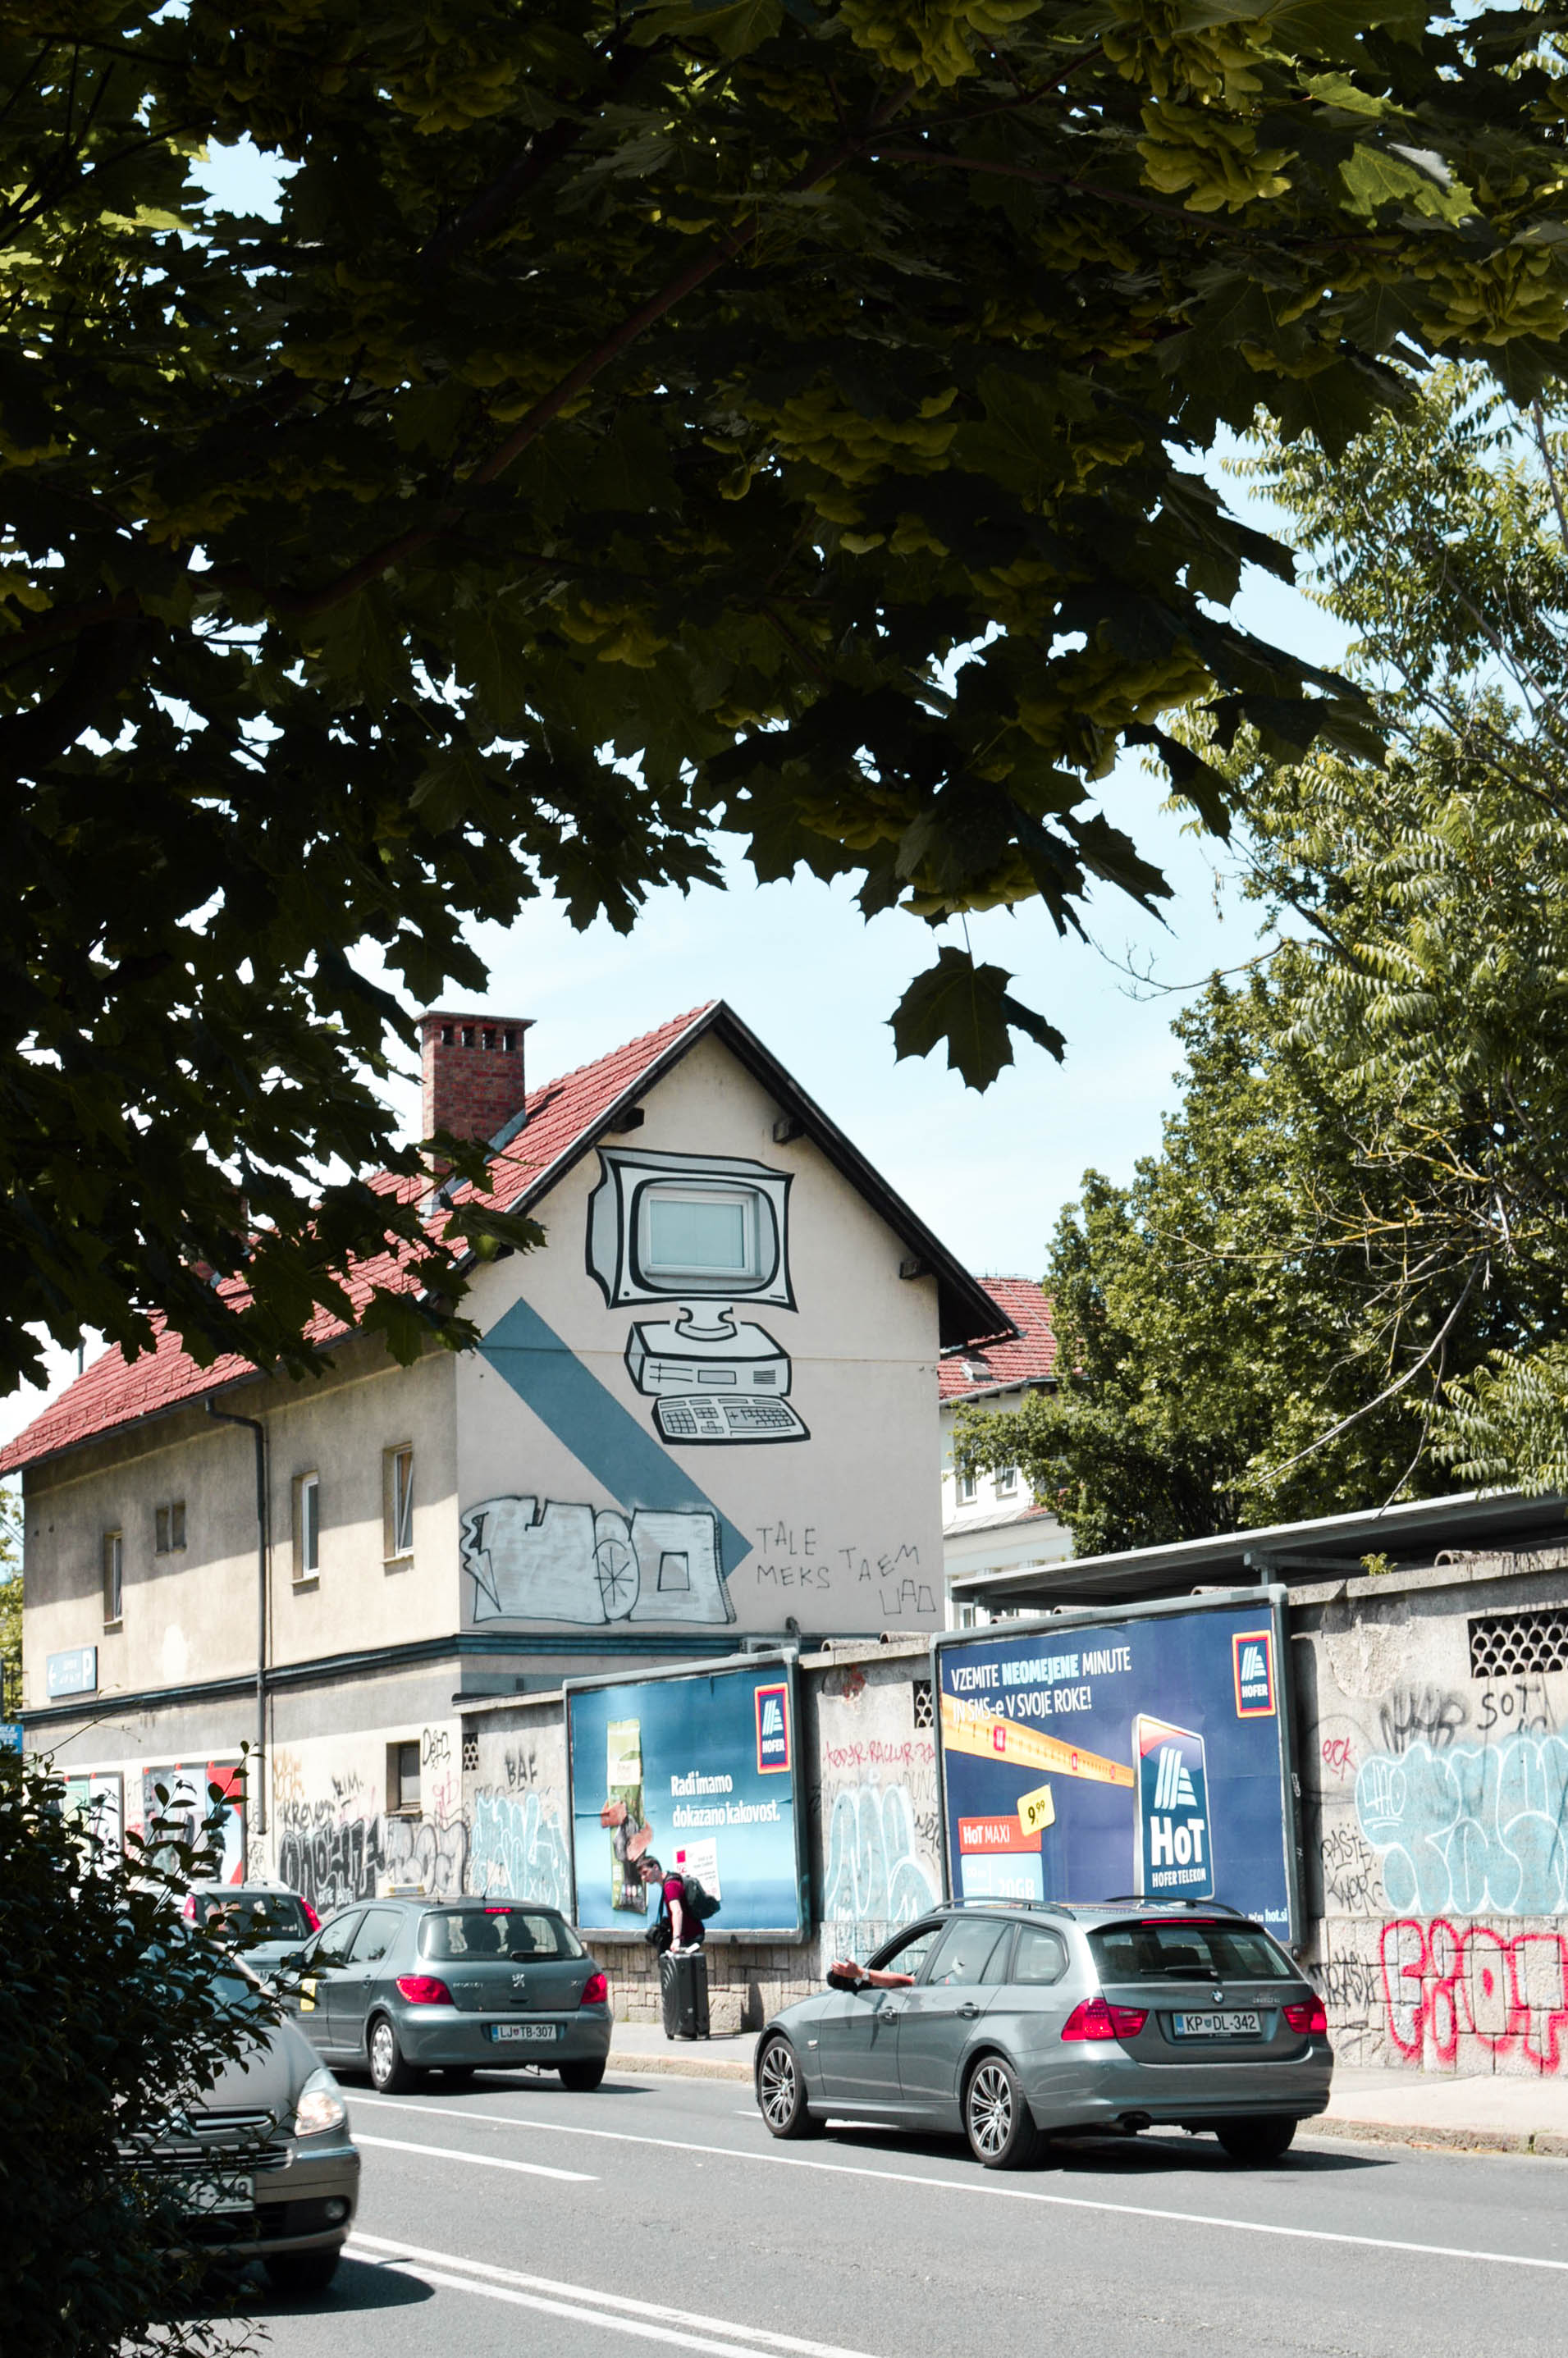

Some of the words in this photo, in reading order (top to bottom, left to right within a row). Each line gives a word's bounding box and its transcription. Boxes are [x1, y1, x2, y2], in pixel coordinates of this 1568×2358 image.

[756, 1520, 816, 1555] TALE
[838, 1544, 919, 1581] TAEM
[757, 1565, 830, 1588] MEKS
[82, 1650, 94, 1688] P
[951, 1664, 1000, 1692] VZEMITE
[1001, 1654, 1080, 1685] NEOMEJENE
[1082, 1647, 1132, 1676] MINUTE
[1241, 1684, 1269, 1699] HOFER
[953, 1701, 966, 1723] IN
[968, 1696, 1004, 1722] SMS-e
[1005, 1695, 1016, 1718] V
[1017, 1690, 1053, 1718] SVOJE
[1054, 1685, 1092, 1713] ROKE!
[761, 1738, 785, 1753] HOFER
[670, 1771, 696, 1797] Radi
[696, 1771, 734, 1794] imamo
[673, 1804, 726, 1828] dokazano
[726, 1799, 781, 1825] kakovost.
[962, 1826, 983, 1844] HoT
[985, 1824, 1011, 1844] MAXI
[1150, 1816, 1205, 1867] HoT
[1152, 1871, 1177, 1888] HOFER
[1178, 1867, 1207, 1885] TELEKOM
[1264, 1908, 1288, 1922] hot.si
[500, 2026, 514, 2038] LJ
[521, 2026, 553, 2038] TB-307
[1185, 2016, 1204, 2031] KP
[1213, 2014, 1257, 2031] DL-342
